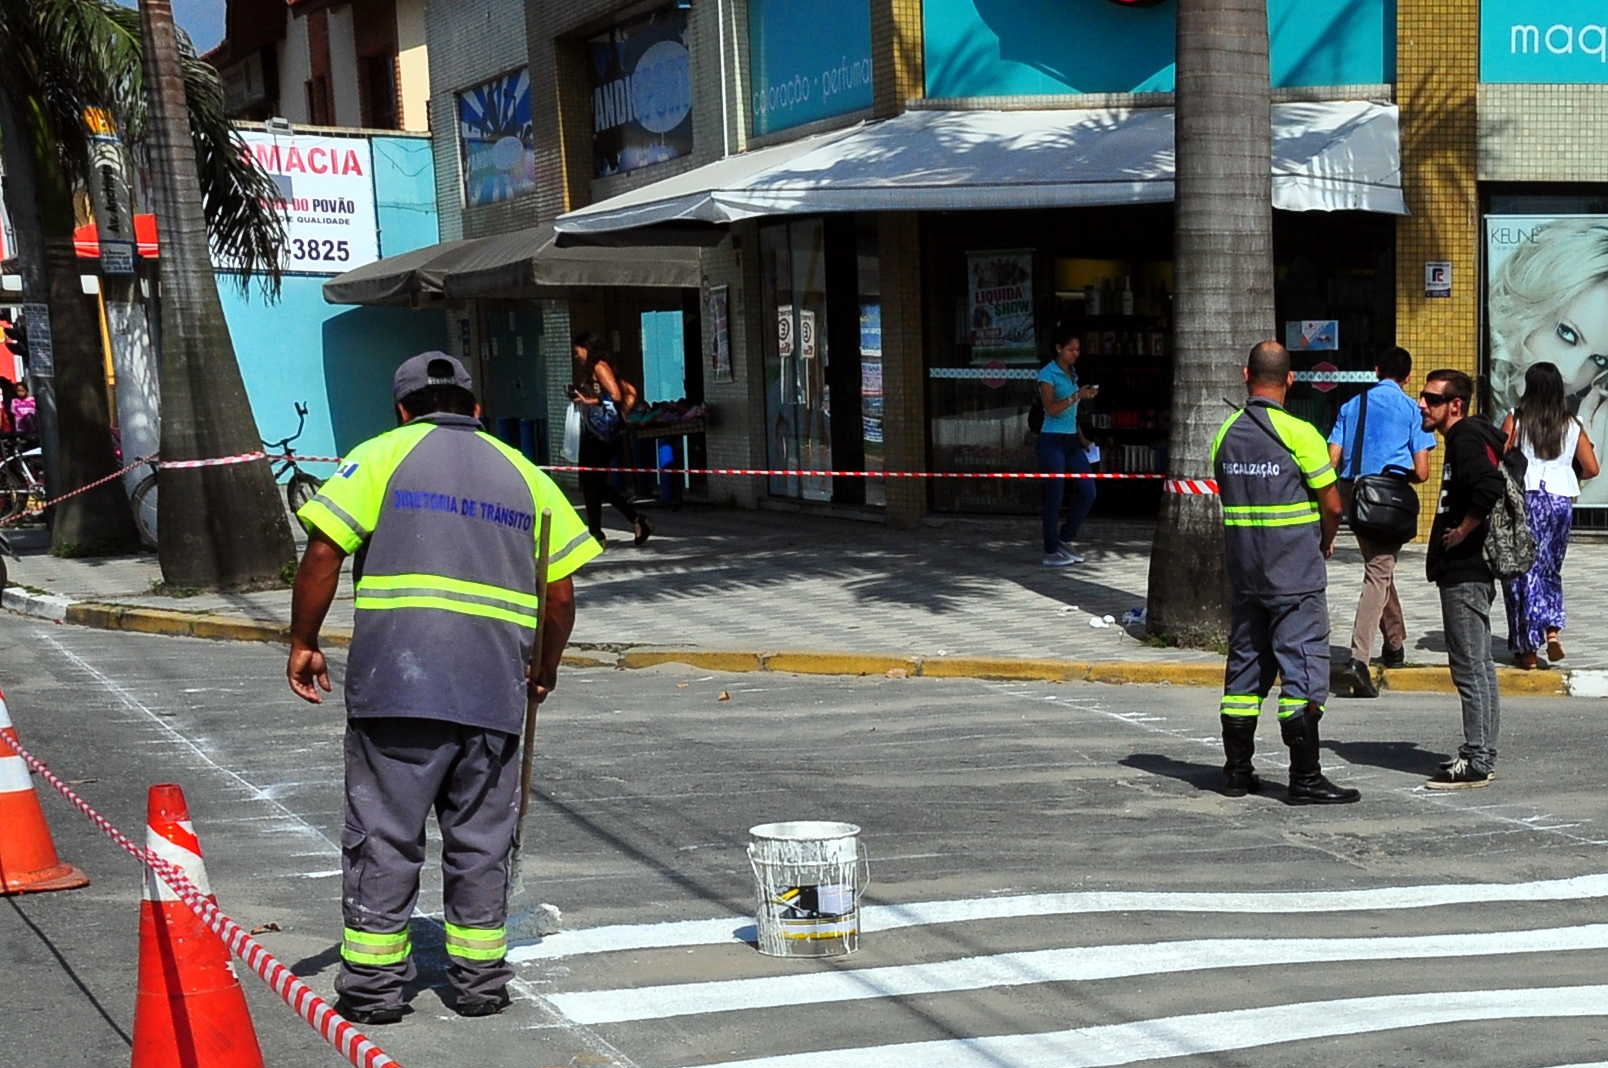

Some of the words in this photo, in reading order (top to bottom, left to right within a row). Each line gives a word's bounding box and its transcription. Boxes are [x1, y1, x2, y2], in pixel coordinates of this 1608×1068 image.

[590, 75, 633, 133] ANDI
[753, 74, 810, 116] coloração
[239, 139, 363, 177] MÁCIA
[292, 197, 309, 212] DO
[312, 197, 355, 214] POVÃO
[297, 216, 351, 225] QUALIDADE
[1490, 228, 1540, 245] KEUNE
[974, 286, 1024, 306] LIQUIDA
[994, 300, 1030, 317] SHOW
[1222, 461, 1280, 478] FISCALIZAÇÃO
[394, 489, 458, 514] DIRETORIA
[461, 498, 476, 517] DE
[481, 502, 532, 531] TRÂNSITO
